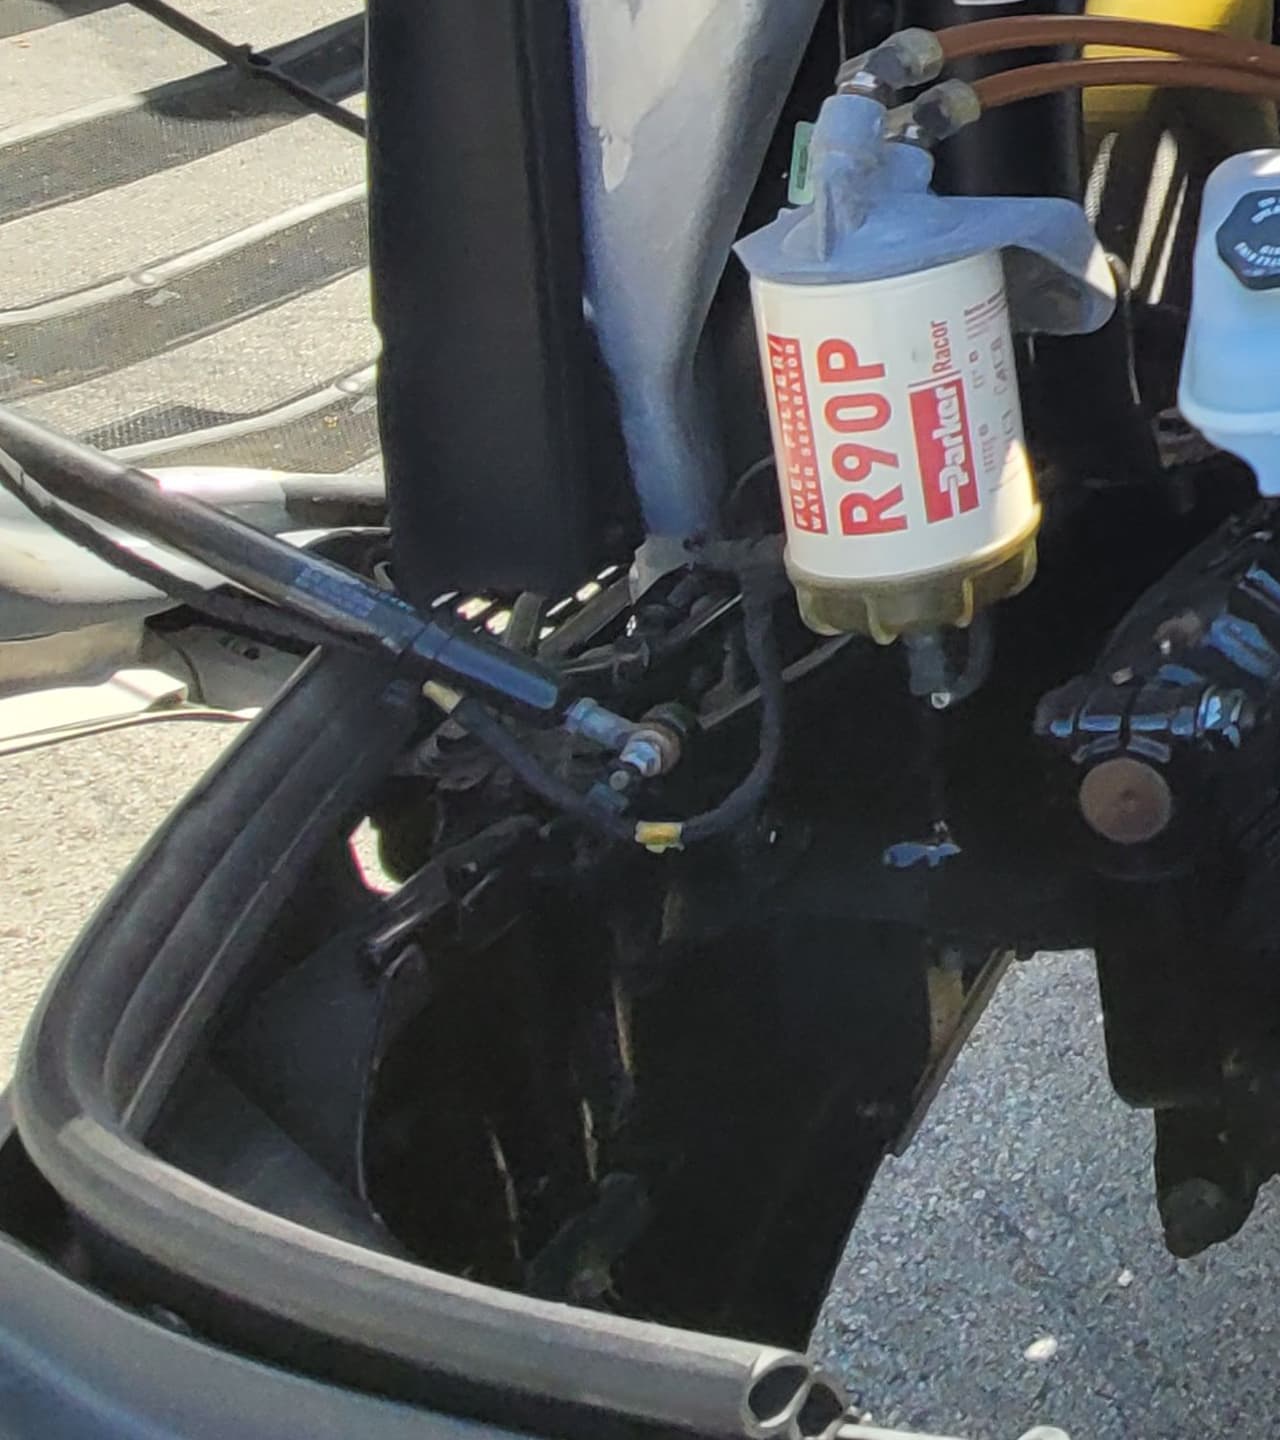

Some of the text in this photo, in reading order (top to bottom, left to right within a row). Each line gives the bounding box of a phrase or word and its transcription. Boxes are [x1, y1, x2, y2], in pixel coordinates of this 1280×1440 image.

[768, 338, 809, 527] FUEL FILTER/
[784, 342, 823, 530] WATER SEPARATOR
[816, 338, 909, 537] R90P
[929, 319, 971, 502] Parker Racor
